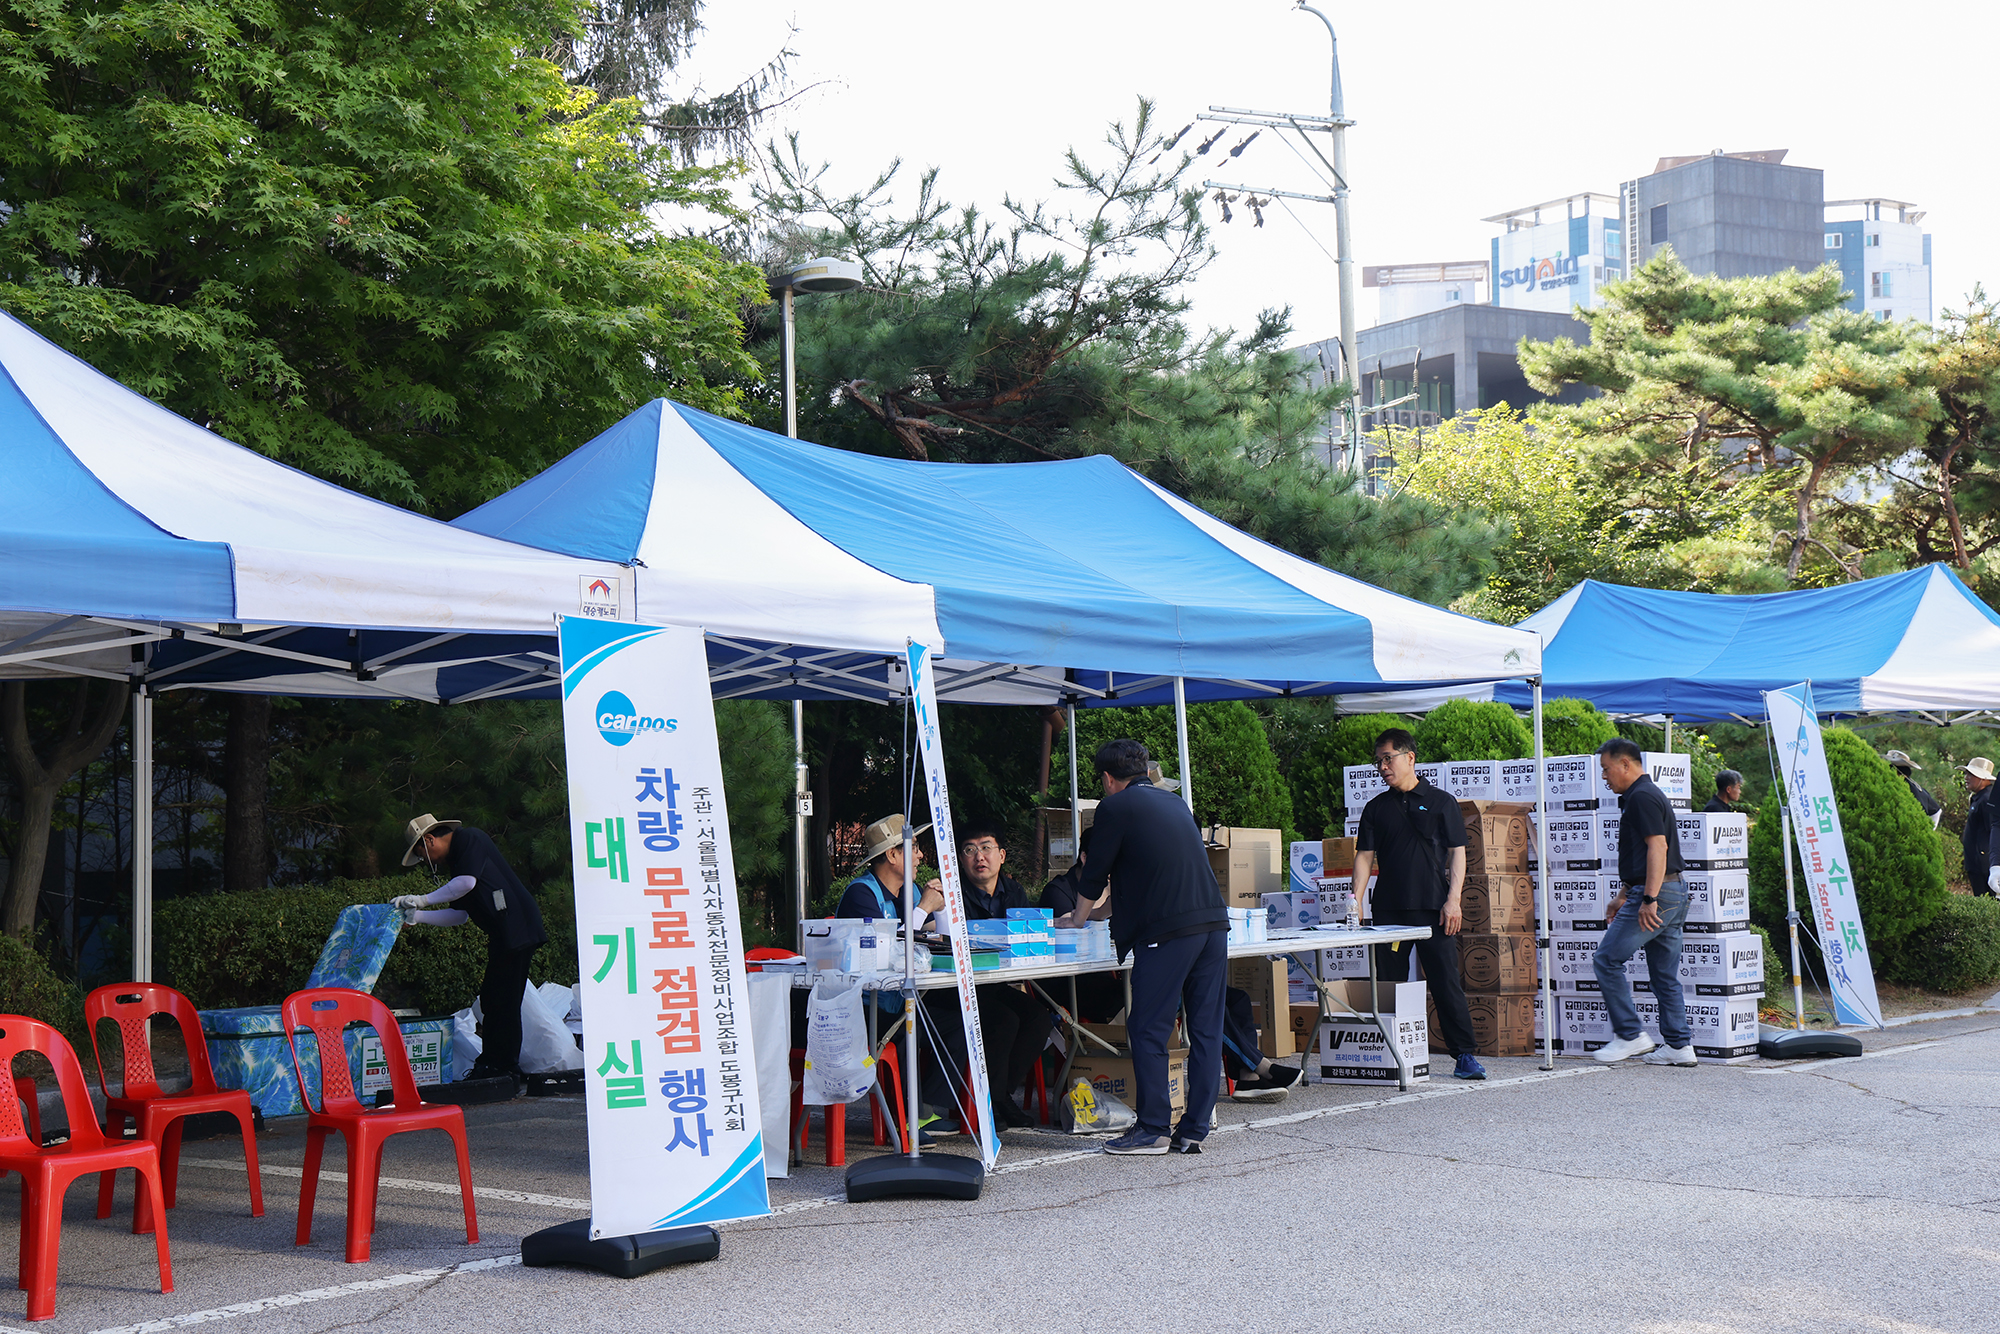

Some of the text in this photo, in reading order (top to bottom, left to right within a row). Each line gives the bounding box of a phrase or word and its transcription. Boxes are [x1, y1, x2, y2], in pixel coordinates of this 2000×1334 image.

[598, 712, 678, 733] carpos
[1503, 775, 1531, 784] 취급주
[1653, 765, 1686, 782] VALCAN
[804, 802, 808, 810] 5
[1713, 827, 1743, 844] VALCAN
[1320, 893, 1346, 902] 취급주
[1719, 888, 1745, 906] VALCAN
[635, 766, 714, 1157] 차량 무료 점검 행사
[1732, 950, 1758, 969] VALCAN
[696, 826, 739, 1056] 서울특별시자동차전문정비사업조합
[718, 1059, 746, 1132] 도봉구지회
[1329, 1030, 1384, 1050] VALCAN
[1335, 1054, 1382, 1062] 프리미엄 워셔액
[1360, 1069, 1386, 1078] 주식회사
